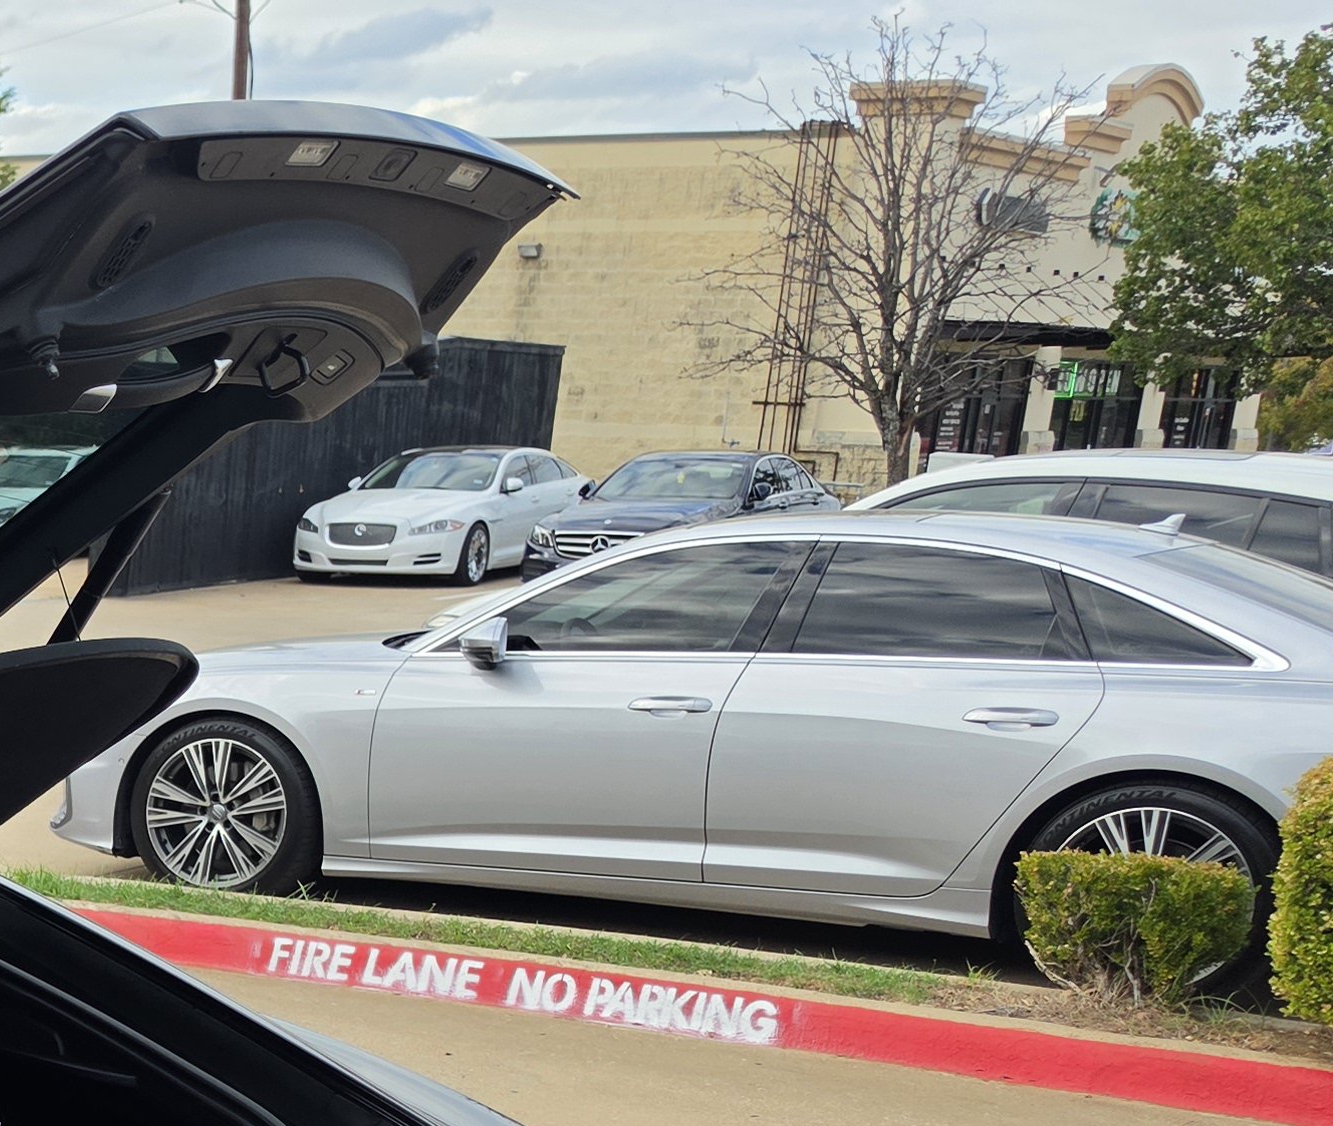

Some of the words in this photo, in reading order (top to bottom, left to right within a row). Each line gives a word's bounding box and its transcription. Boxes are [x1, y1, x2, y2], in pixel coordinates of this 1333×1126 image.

[268, 937, 356, 982] FIRE
[361, 947, 485, 999] LANE
[505, 967, 577, 1012] NO
[583, 977, 780, 1045] PARKING
